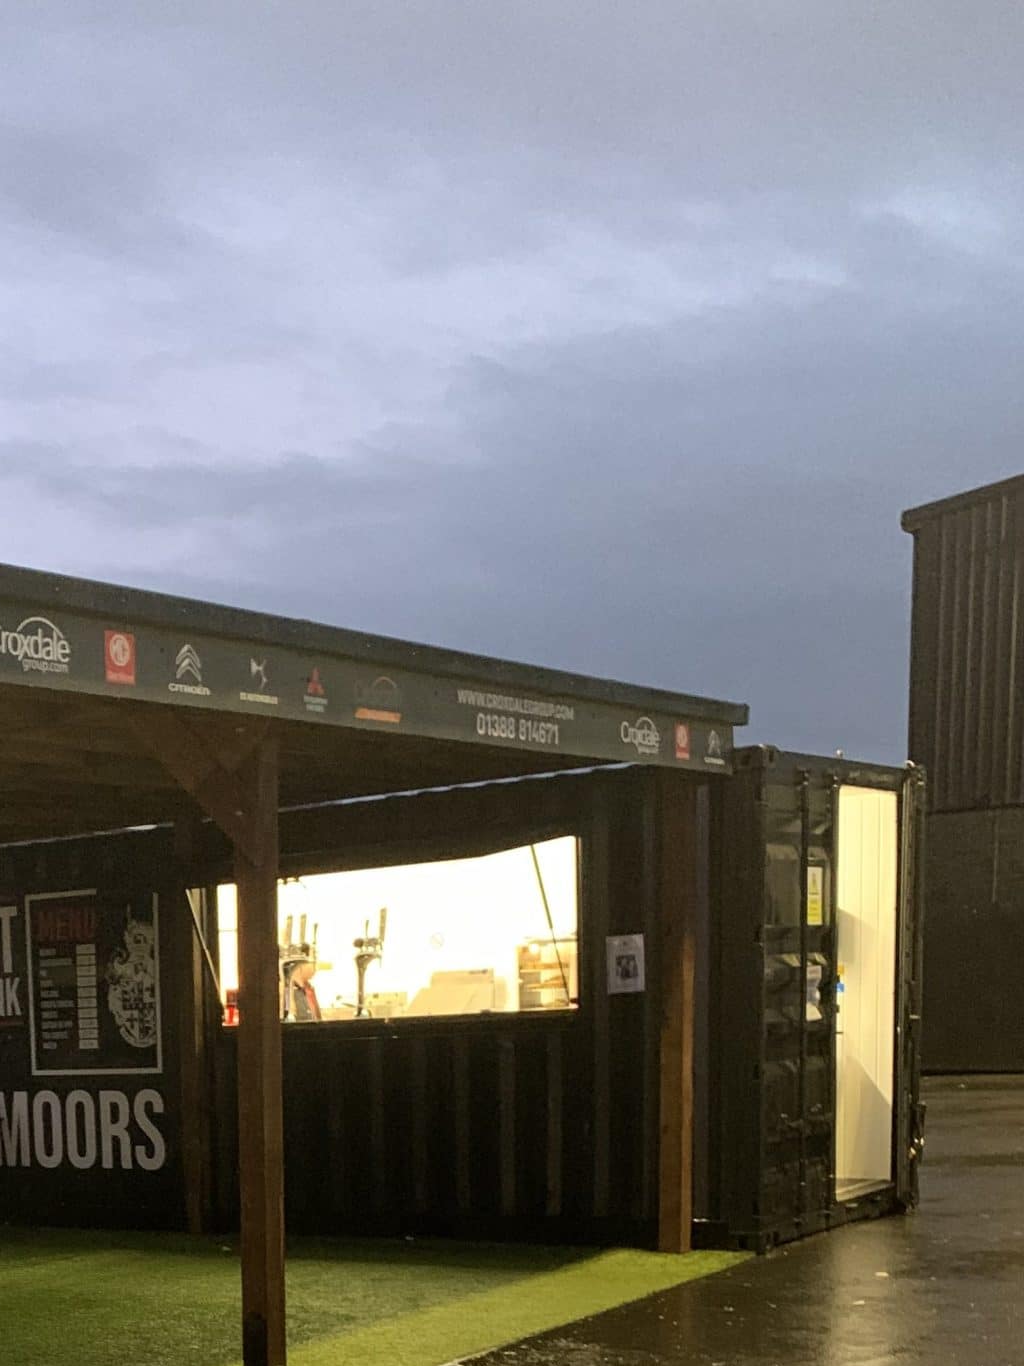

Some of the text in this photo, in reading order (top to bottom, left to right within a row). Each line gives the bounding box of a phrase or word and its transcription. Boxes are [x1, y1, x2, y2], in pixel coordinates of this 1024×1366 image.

[22, 658, 69, 674] group.com
[476, 713, 559, 745] 01388 814671
